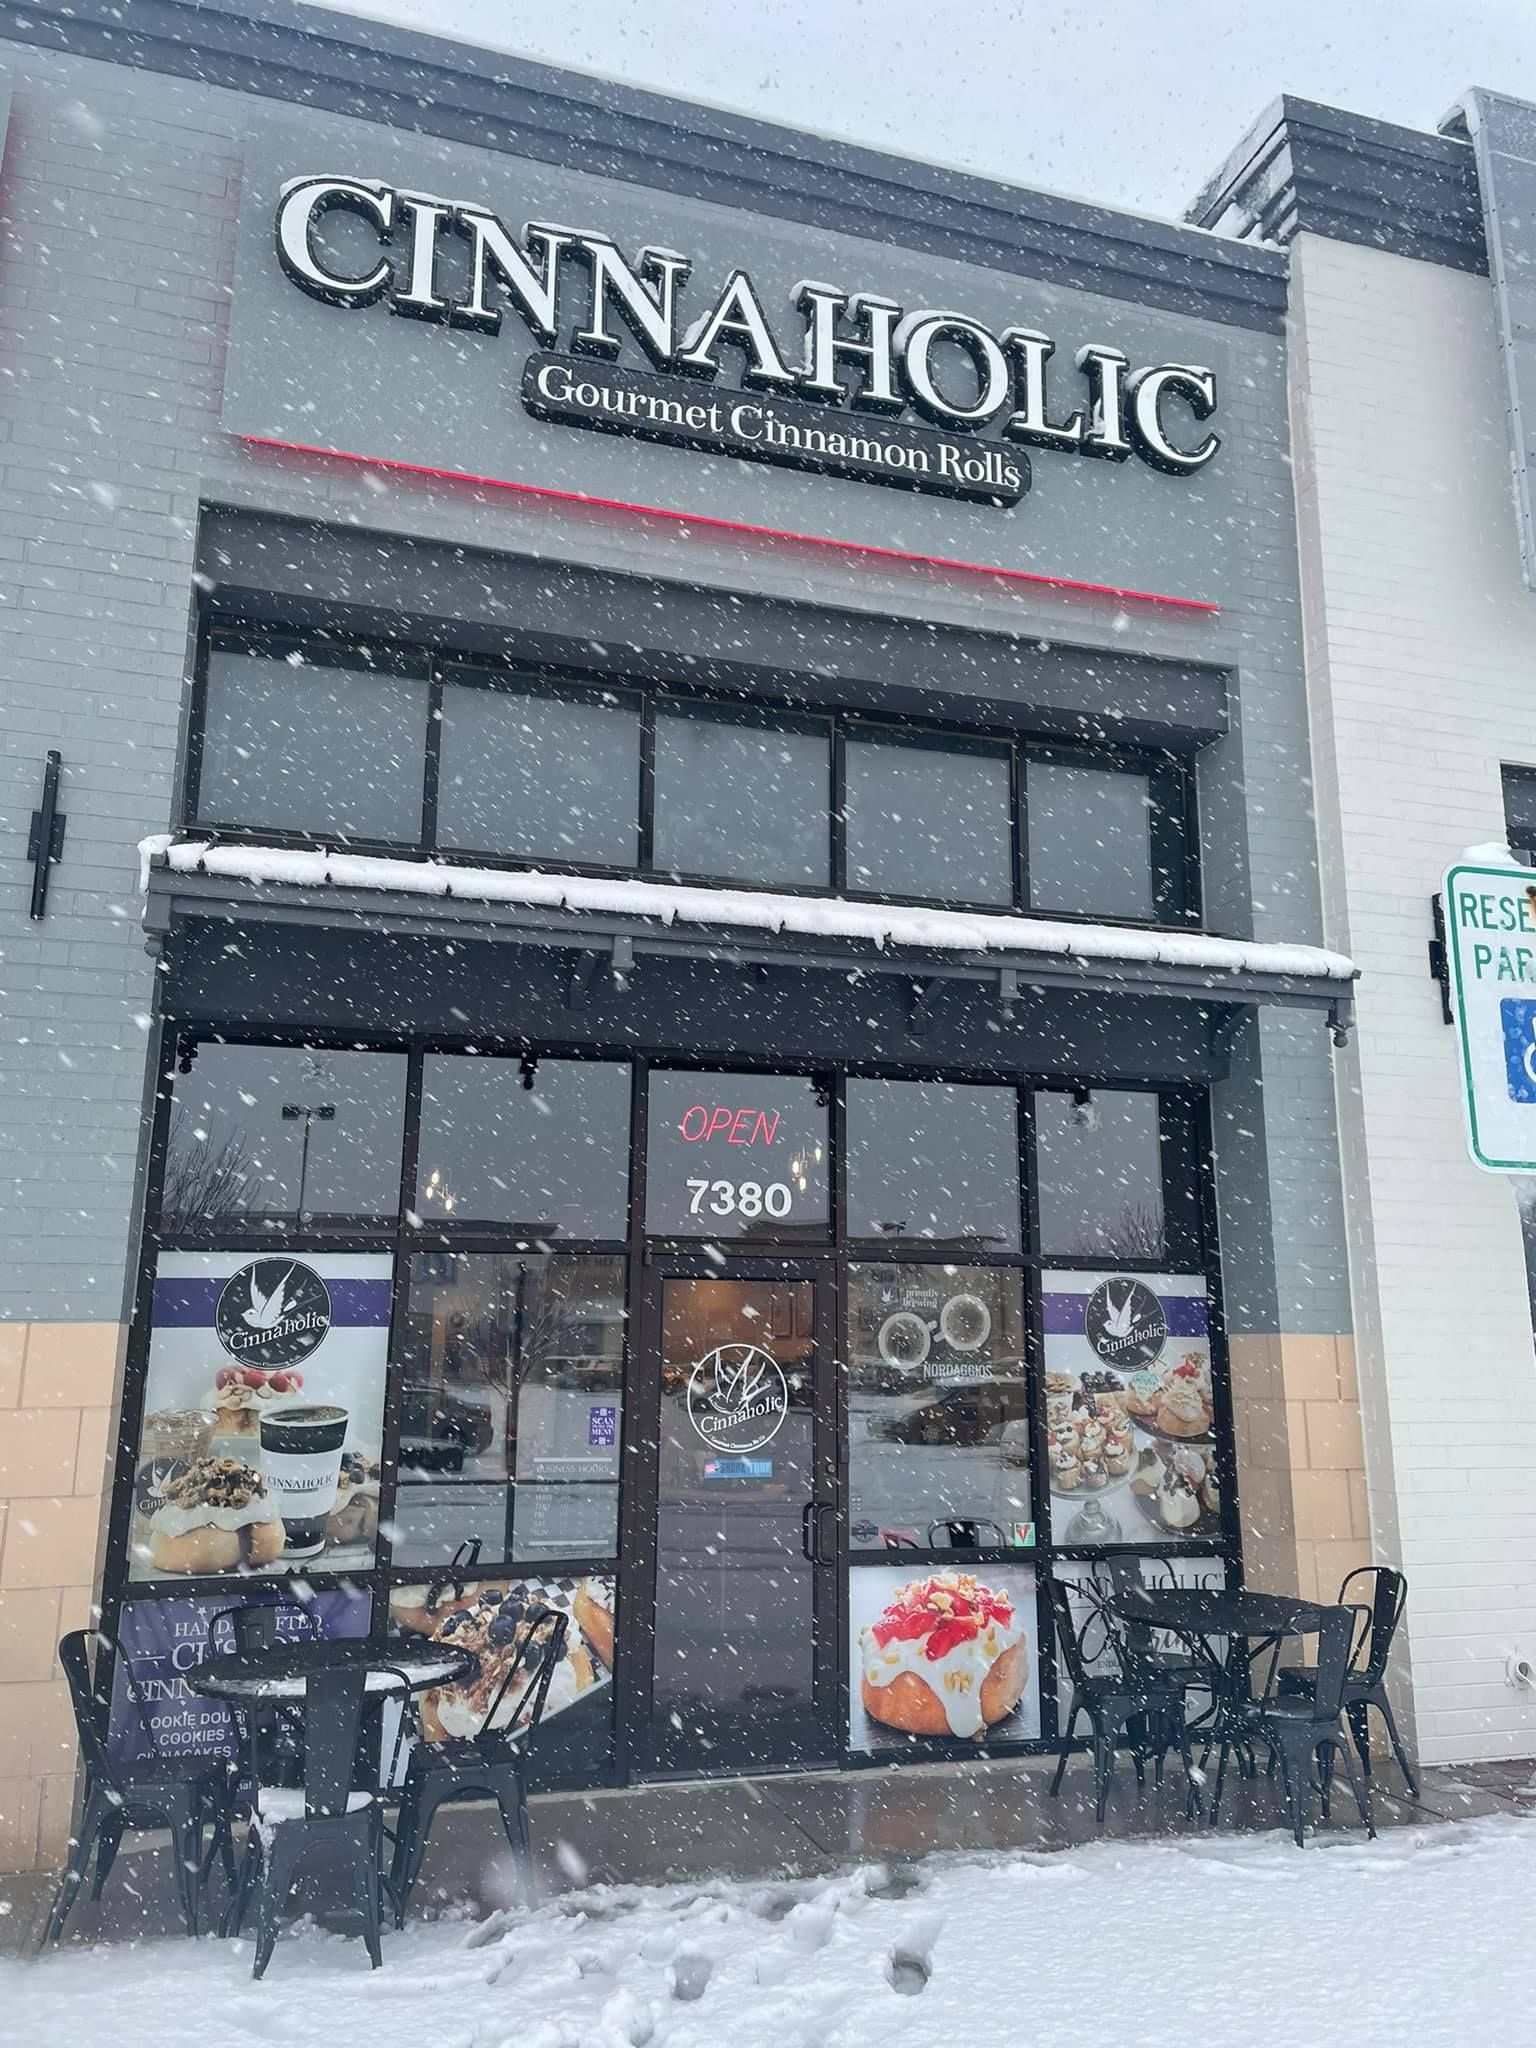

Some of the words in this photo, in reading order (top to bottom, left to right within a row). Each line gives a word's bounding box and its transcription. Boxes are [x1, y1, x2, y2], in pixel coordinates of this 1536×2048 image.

[274, 176, 1222, 474] CINNAHOLIC
[537, 365, 724, 433] Gourmet
[730, 404, 930, 473] Cinnamon
[937, 443, 1021, 489] Rolls
[682, 1105, 781, 1145] OPEN
[686, 1179, 793, 1217] 7380
[229, 1312, 328, 1350] Cinnaholic
[1097, 1323, 1166, 1354] Cinnaholic
[923, 1362, 993, 1379] NORDAGGIOS
[591, 1416, 615, 1426] SCAN
[700, 1396, 783, 1433] Cinnaholic
[267, 1472, 334, 1489] CINNAHOLIC
[160, 1729, 225, 1746] COOKIES
